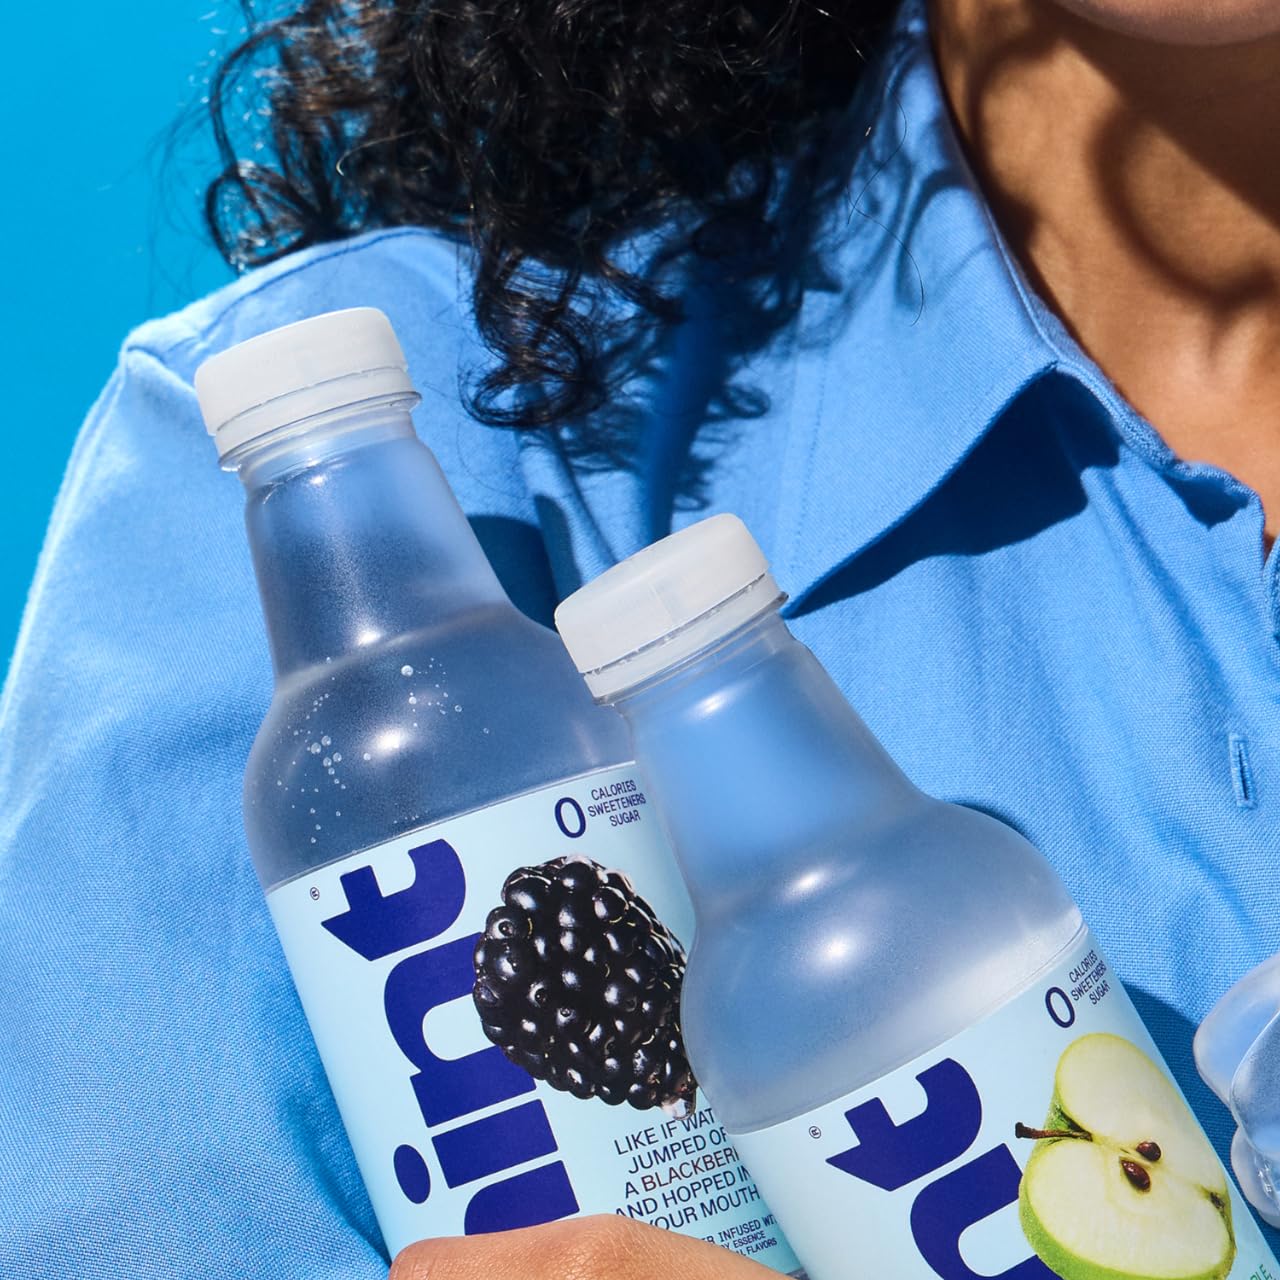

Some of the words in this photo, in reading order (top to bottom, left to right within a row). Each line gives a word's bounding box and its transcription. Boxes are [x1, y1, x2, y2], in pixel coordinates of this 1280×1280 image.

[588, 793, 647, 817] SWEETENERS
[591, 780, 637, 801] CALORIES
[555, 797, 586, 838] 0
[609, 810, 641, 827] SUGAR
[1069, 950, 1098, 983] CALORIES
[1071, 960, 1107, 1001] SWEETENERS
[1045, 986, 1075, 1028] 0
[1089, 980, 1111, 1005] SUGAR
[614, 1127, 659, 1155] LIKE
[660, 1119, 678, 1139] IF
[682, 1108, 715, 1132] WAT
[628, 1134, 707, 1174] JUMPED
[625, 1181, 639, 1198] A
[641, 1146, 739, 1192] BLACKBER
[662, 1170, 736, 1208] HOPPED
[650, 1206, 698, 1230] OUR
[700, 1184, 760, 1218] MOUTH
[718, 1219, 760, 1242] INFUSED
[733, 1230, 766, 1248] ESSENCE
[746, 1237, 777, 1254] FLAVORS
